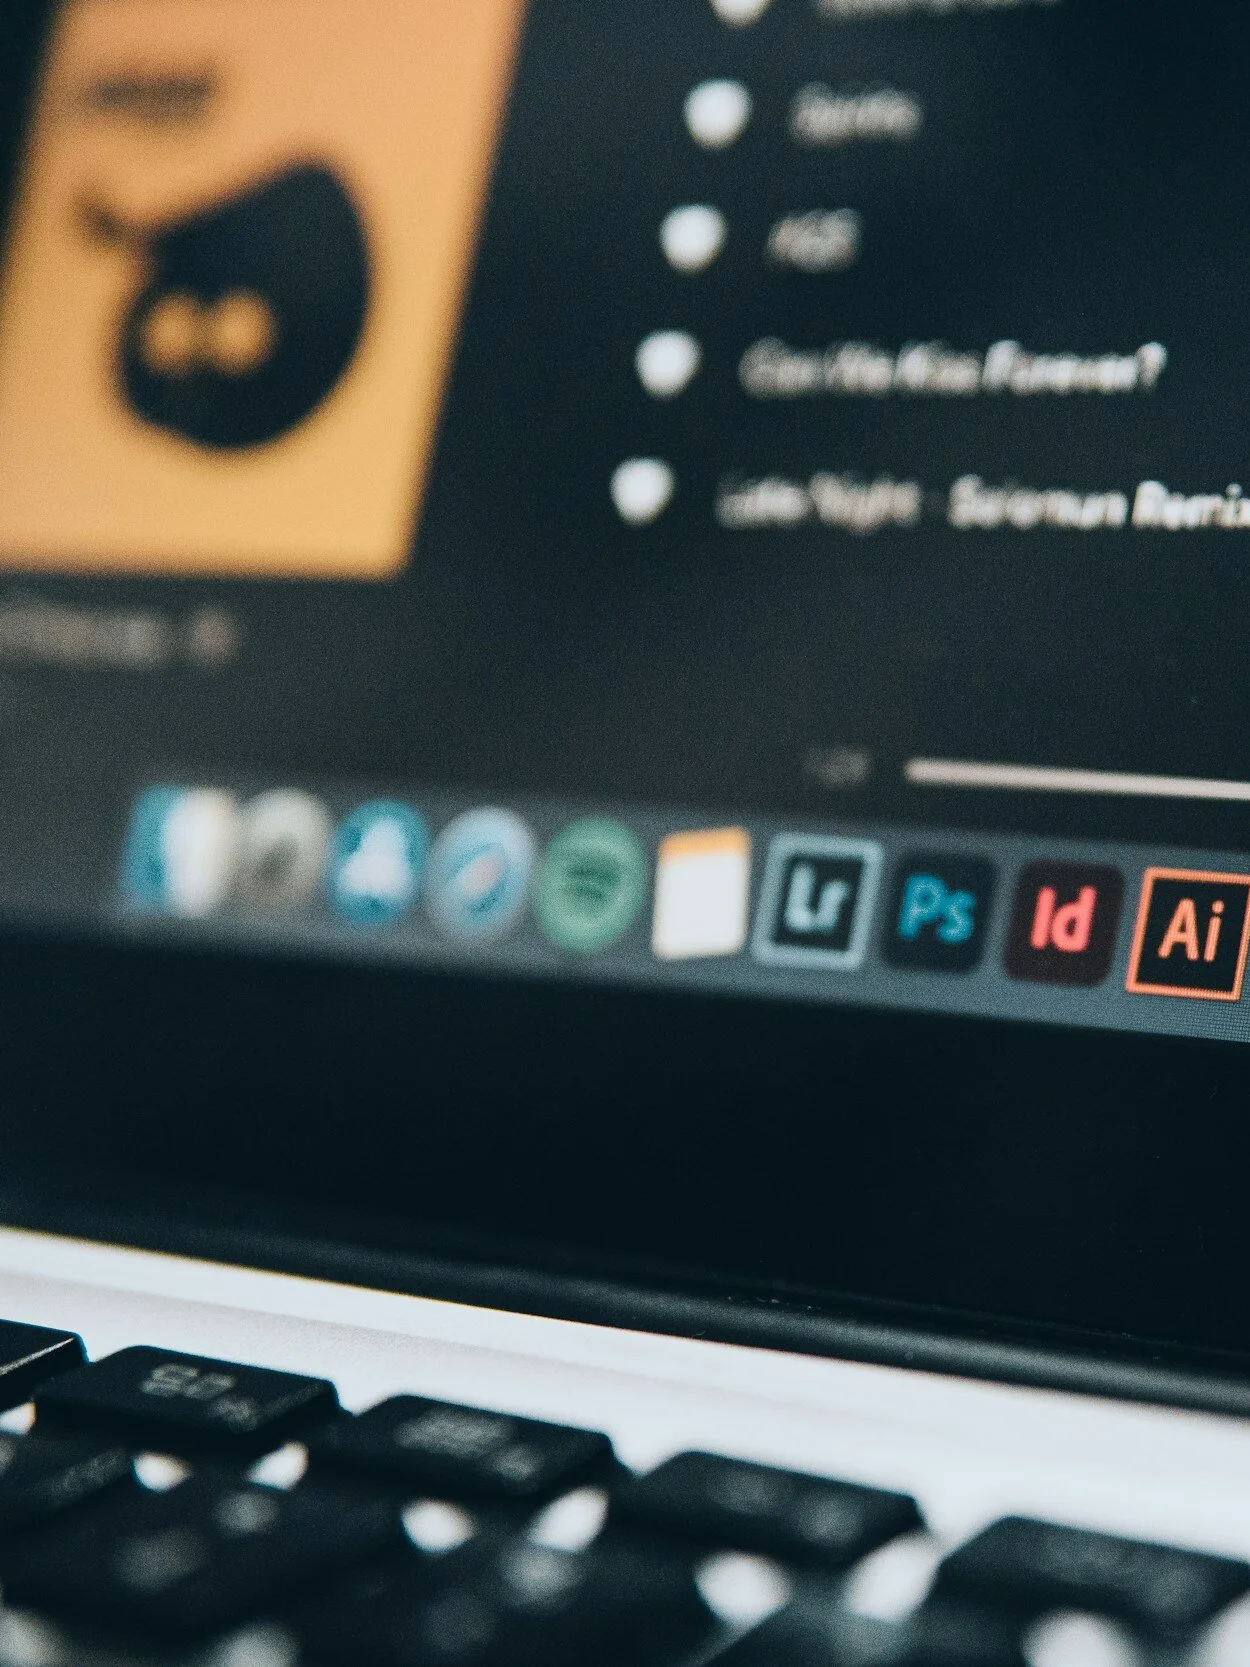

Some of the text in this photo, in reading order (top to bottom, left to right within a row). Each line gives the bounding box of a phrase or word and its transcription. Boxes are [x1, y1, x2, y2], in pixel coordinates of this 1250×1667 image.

[898, 873, 976, 945] Ps
[1030, 883, 1097, 953] Id
[1156, 898, 1226, 963] Ai
